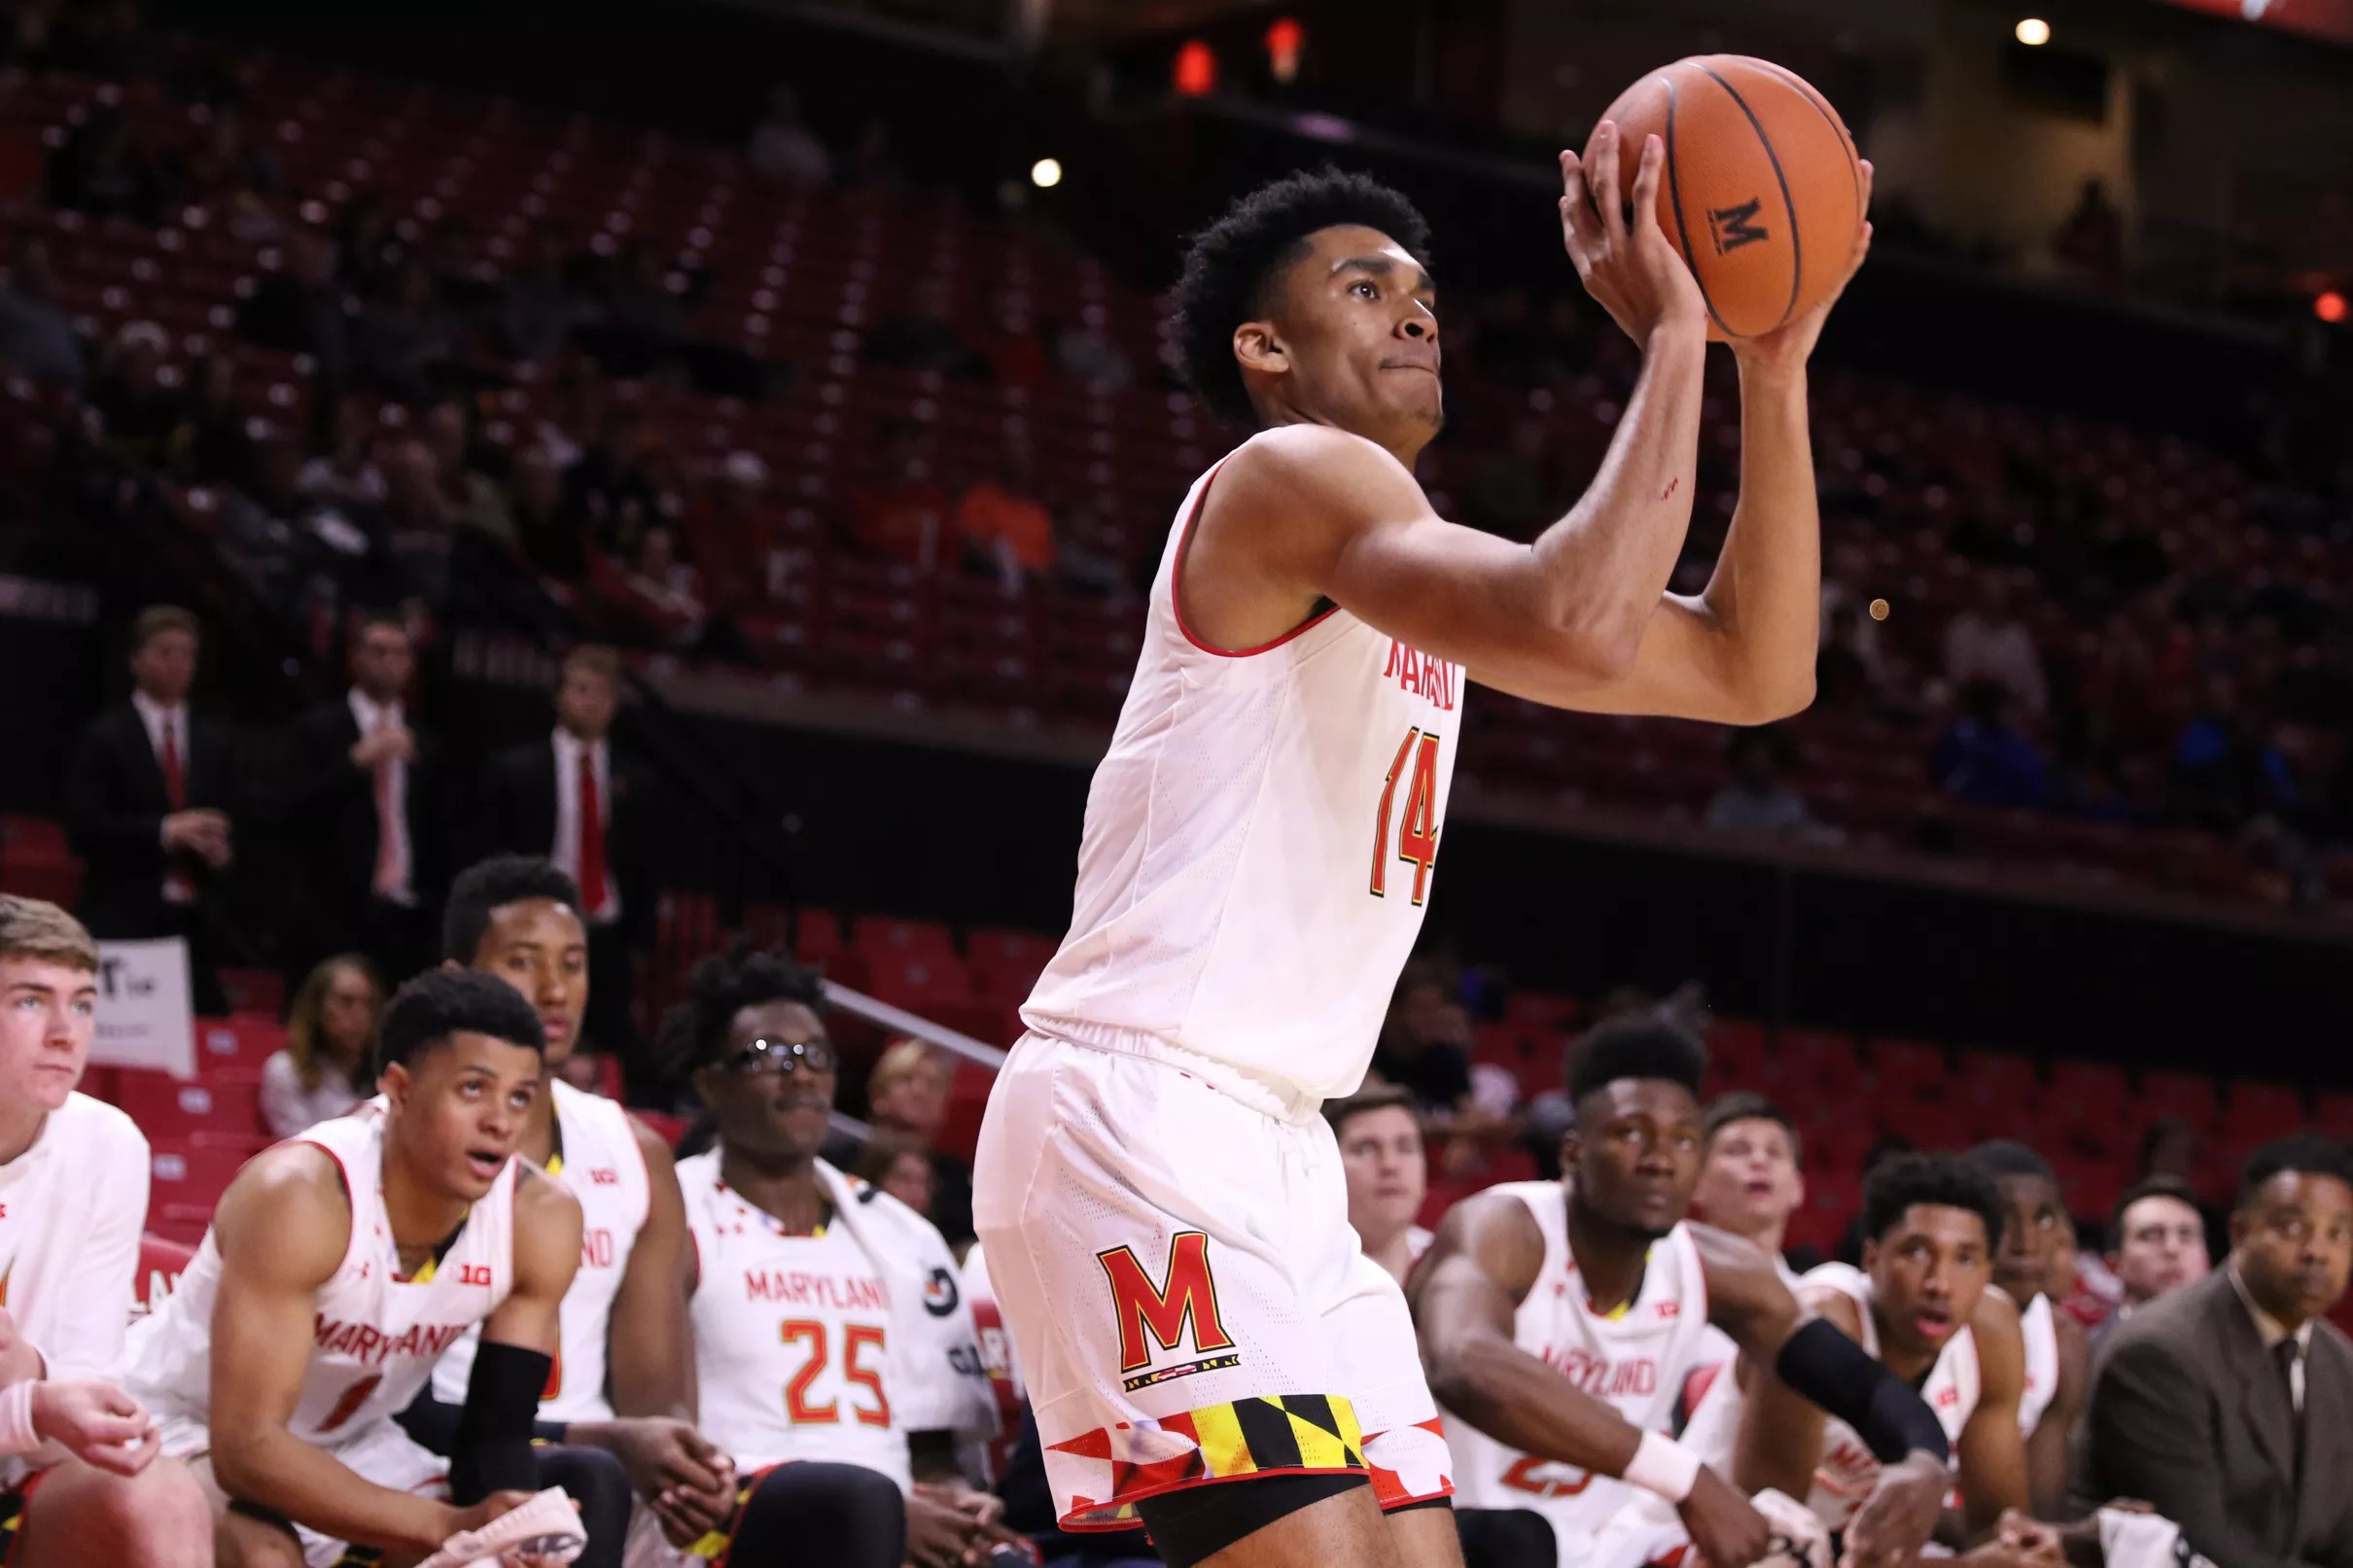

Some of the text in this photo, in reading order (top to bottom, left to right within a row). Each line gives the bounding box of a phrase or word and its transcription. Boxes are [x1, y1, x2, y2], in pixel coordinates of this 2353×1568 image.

[1370, 726, 1439, 907] 14
[781, 1319, 891, 1429] 25
[1096, 1231, 1236, 1374] M
